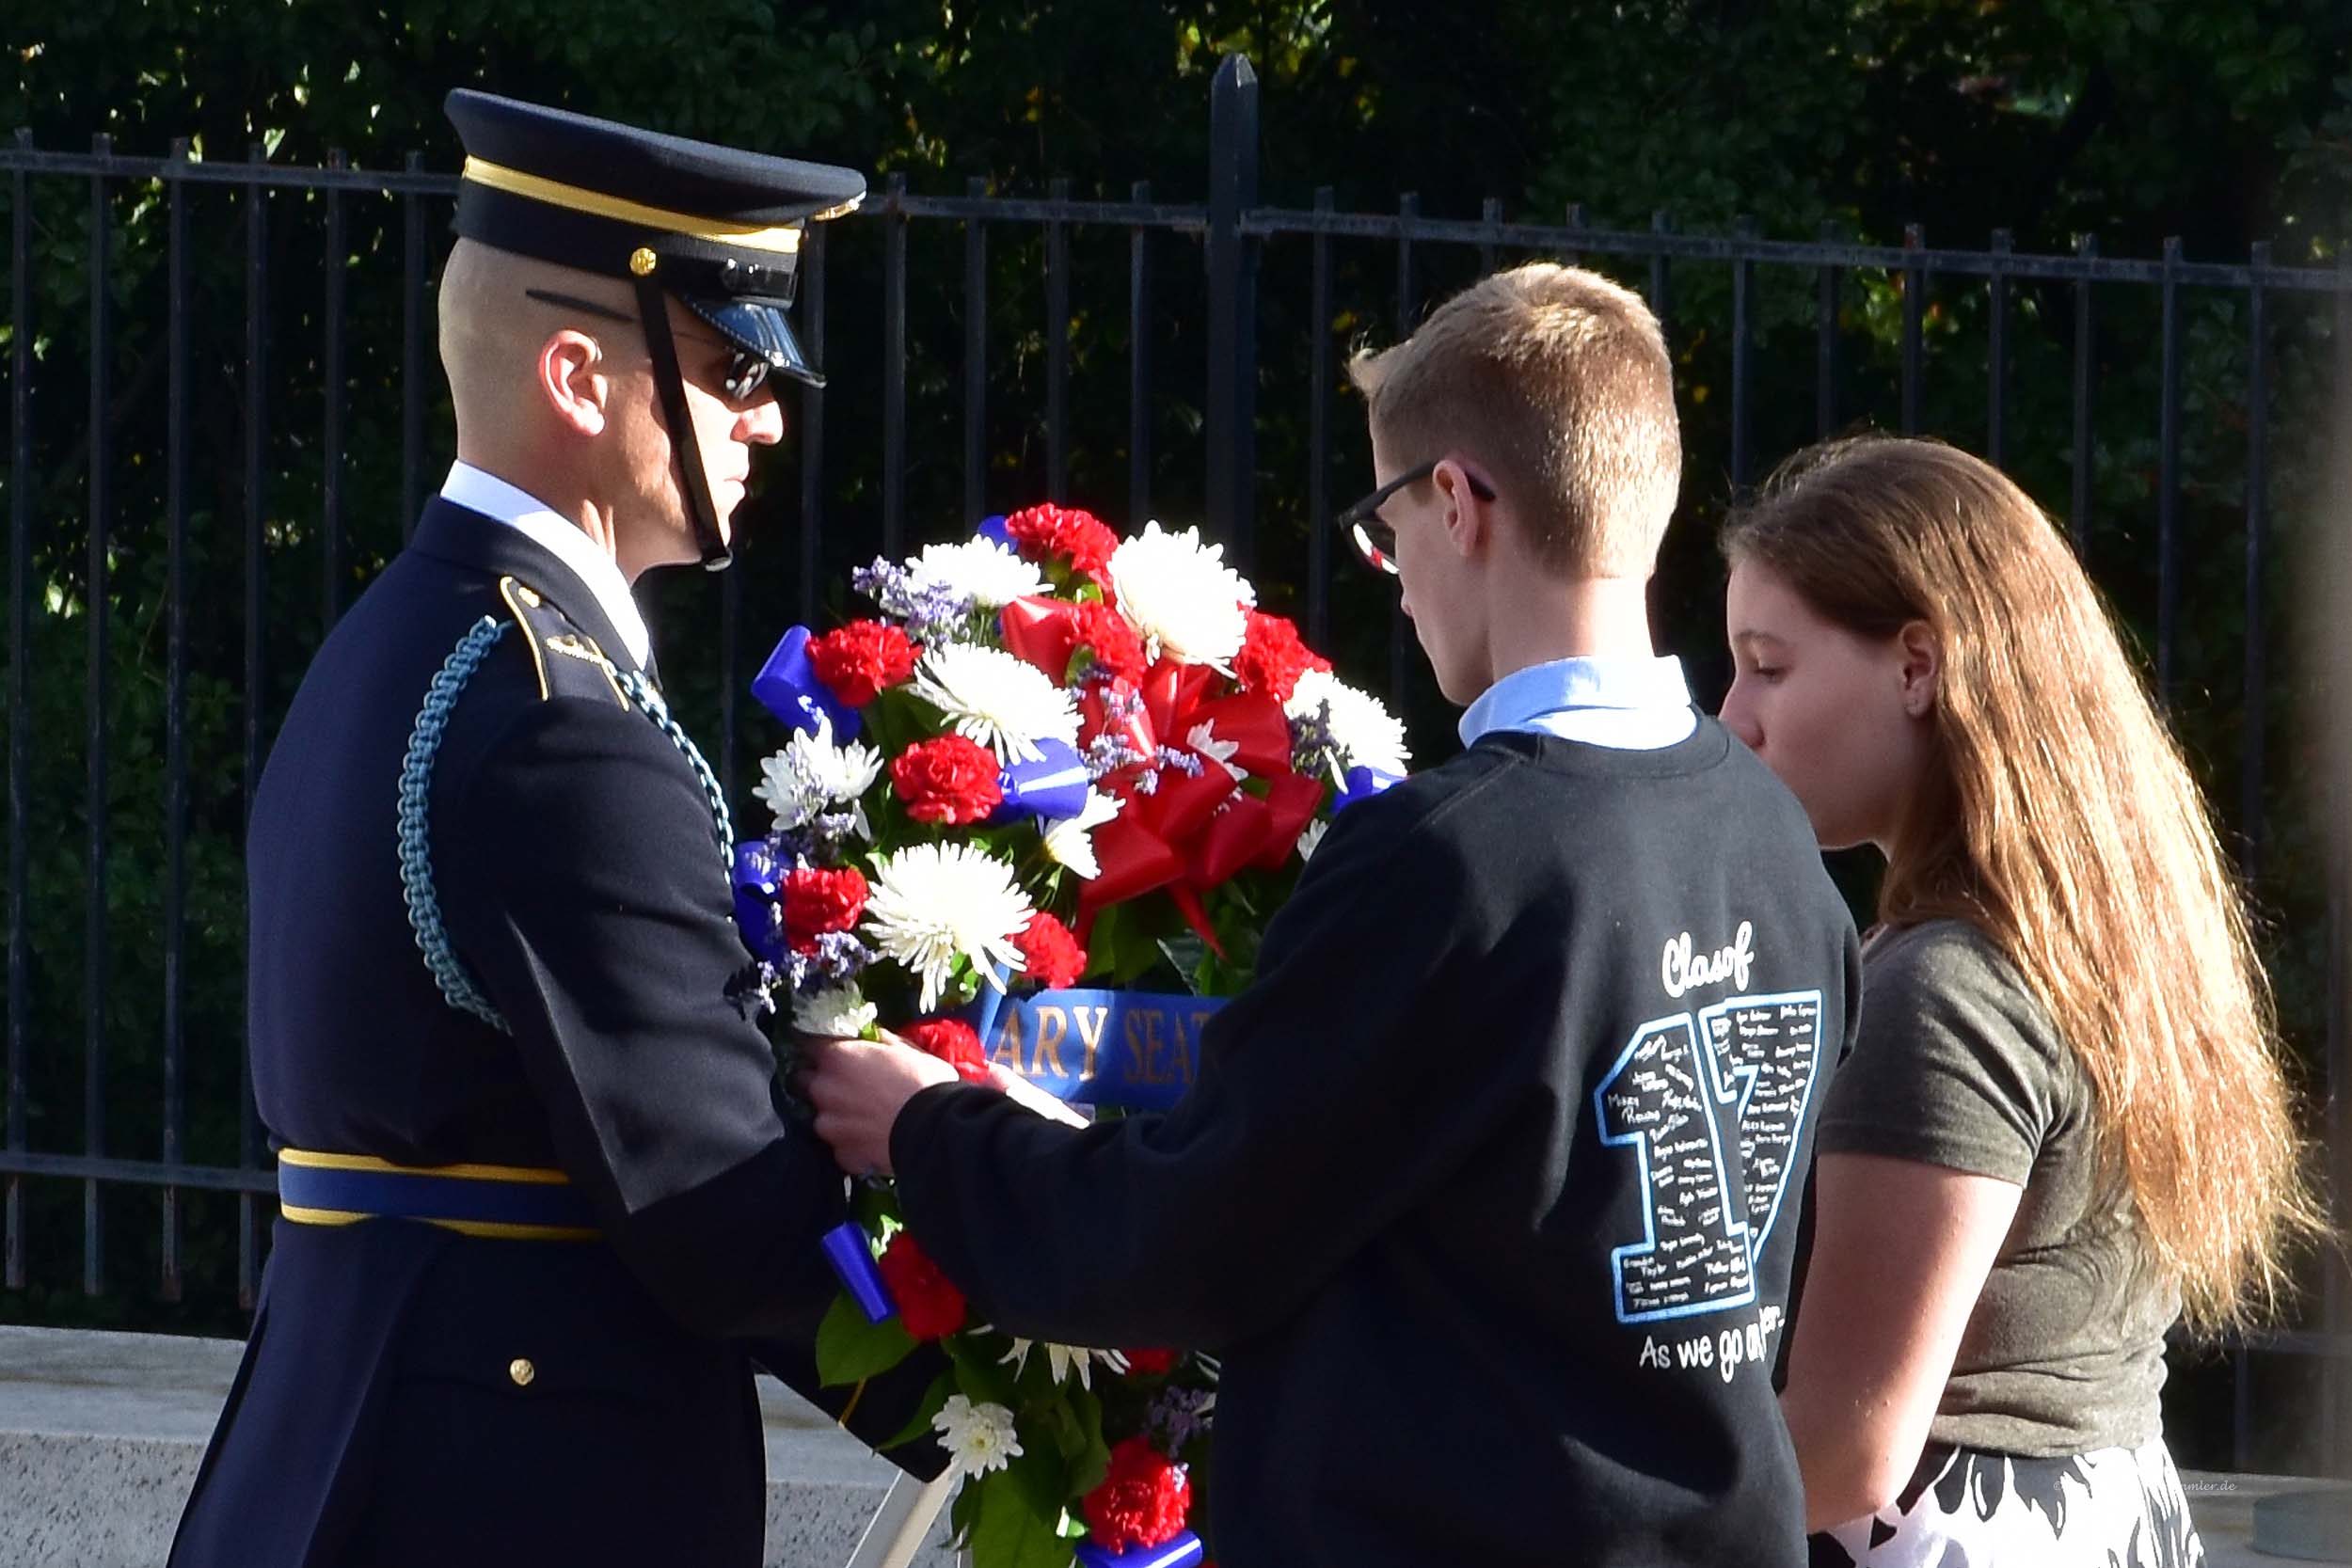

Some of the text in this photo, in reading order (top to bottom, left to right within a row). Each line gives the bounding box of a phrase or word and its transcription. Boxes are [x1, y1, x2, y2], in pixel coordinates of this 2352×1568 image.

[1639, 1335, 1671, 1370] As
[1677, 1335, 1714, 1370] we
[1719, 1328, 1743, 1384] go
